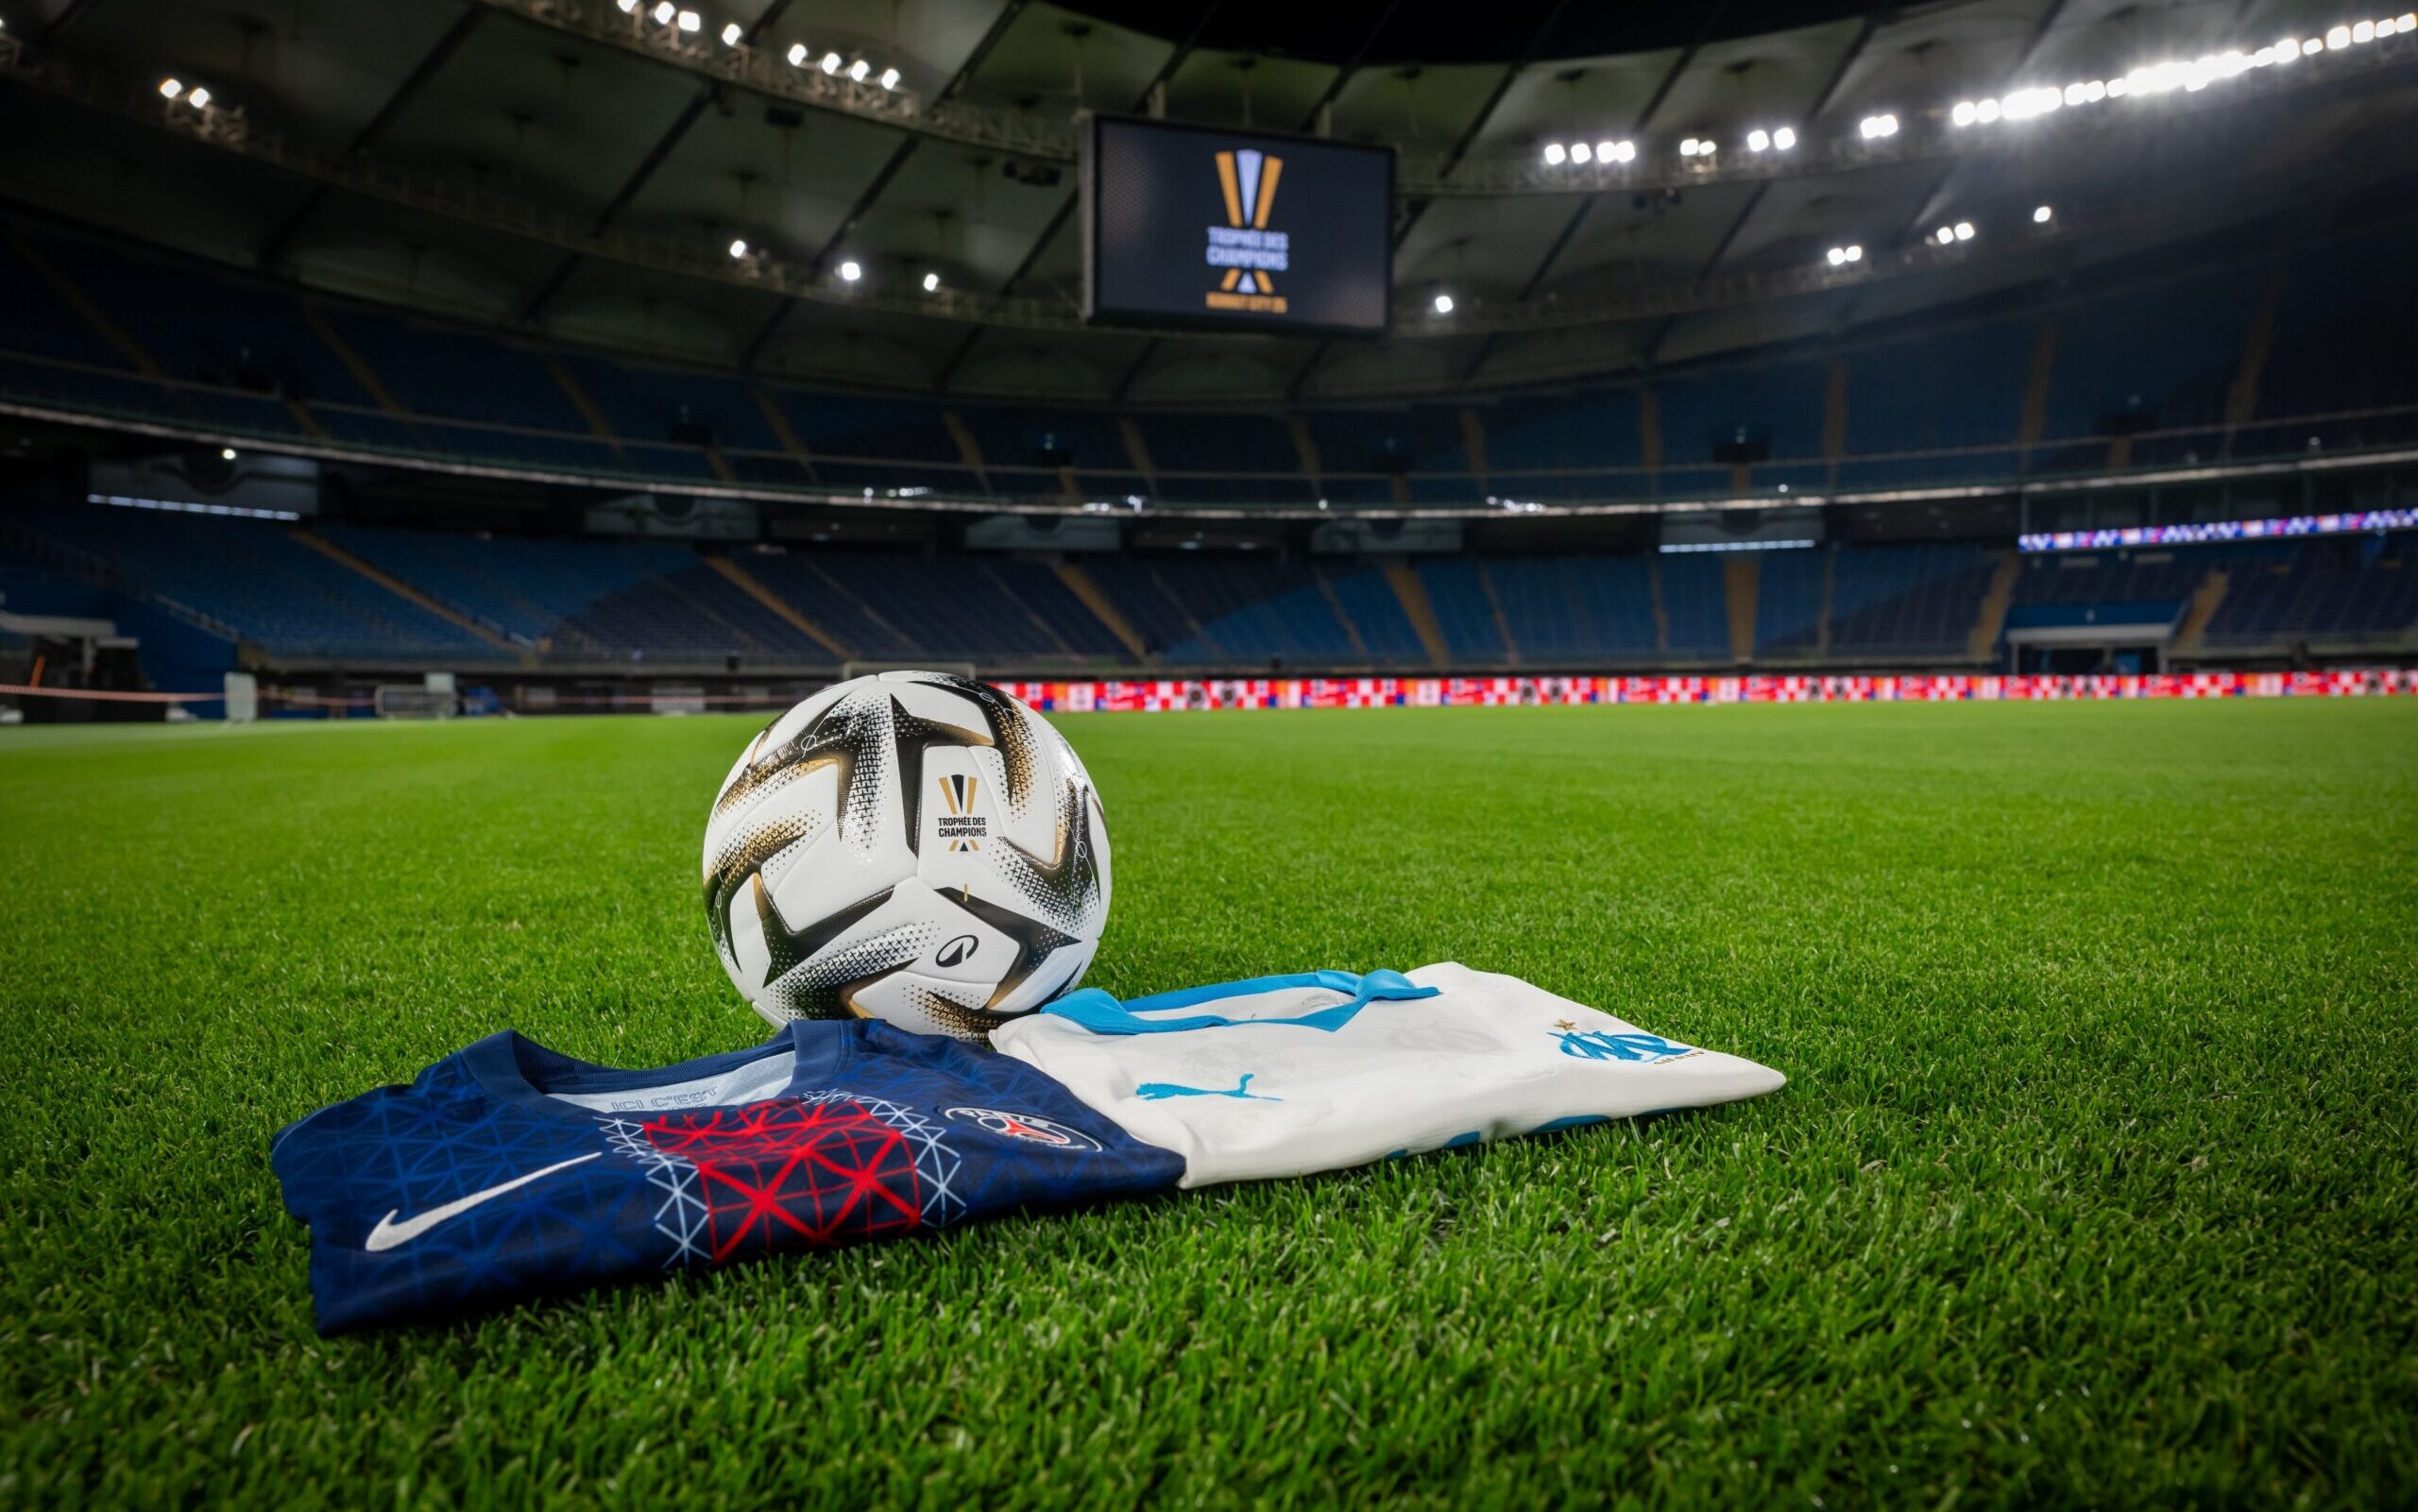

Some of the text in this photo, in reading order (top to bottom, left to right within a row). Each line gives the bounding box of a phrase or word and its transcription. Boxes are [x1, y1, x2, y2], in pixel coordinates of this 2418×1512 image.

[1206, 246, 1288, 270] CHAMPIONS
[938, 816, 986, 826] TROPHÉE DES
[938, 827, 987, 838] CHAMPIONS
[611, 1099, 644, 1111] ICI
